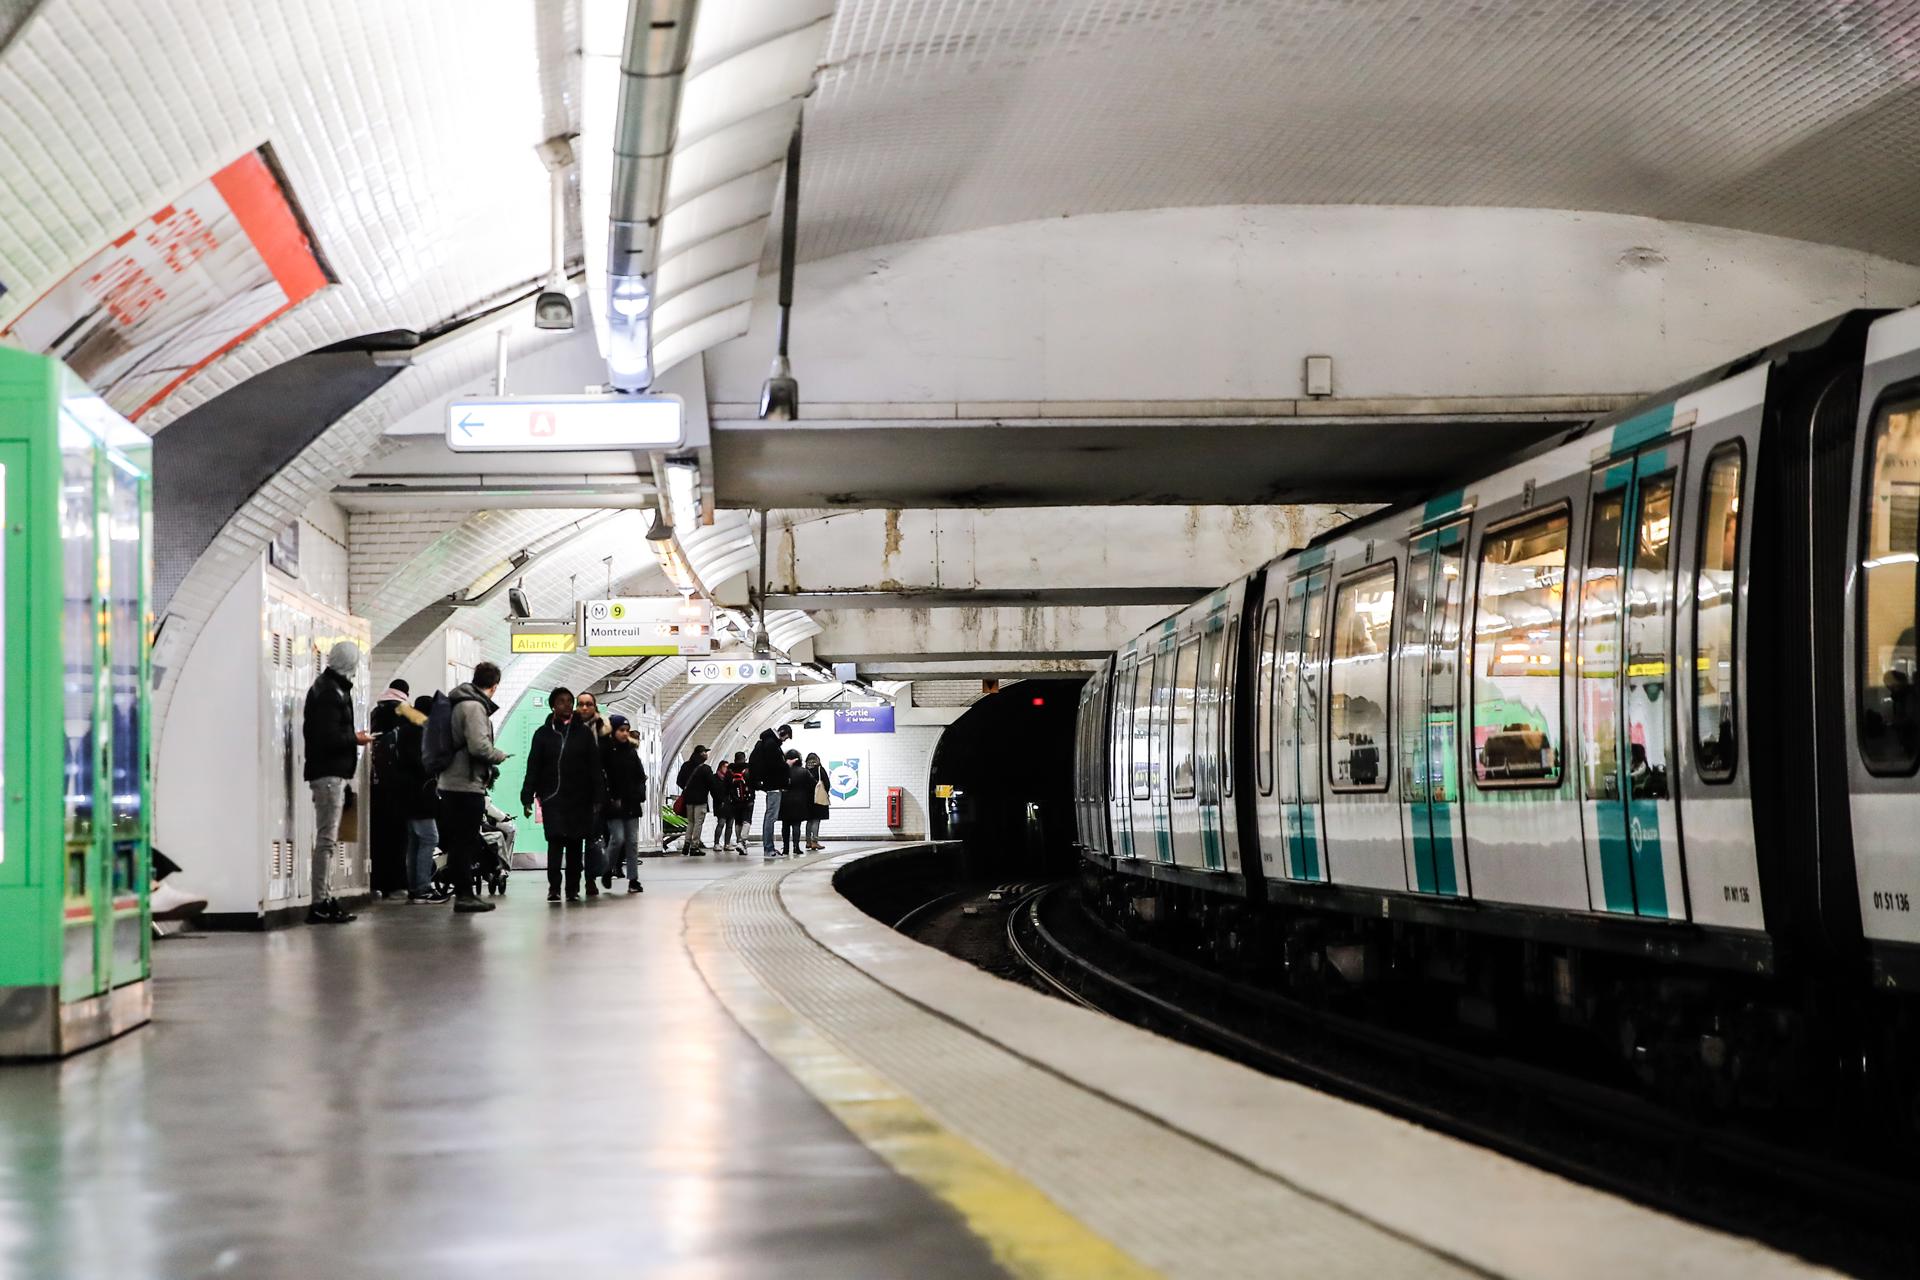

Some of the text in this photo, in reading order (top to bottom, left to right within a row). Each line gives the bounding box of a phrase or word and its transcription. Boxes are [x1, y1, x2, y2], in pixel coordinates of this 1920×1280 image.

[534, 414, 552, 433] A
[614, 606, 621, 616] 9
[590, 627, 640, 636] Montreuil
[517, 639, 558, 649] Alarme
[726, 666, 731, 676] 1
[742, 666, 750, 676] 2
[760, 666, 767, 675] 6
[845, 708, 869, 717] Sortie
[1873, 891, 1910, 912] 01 S1 136
